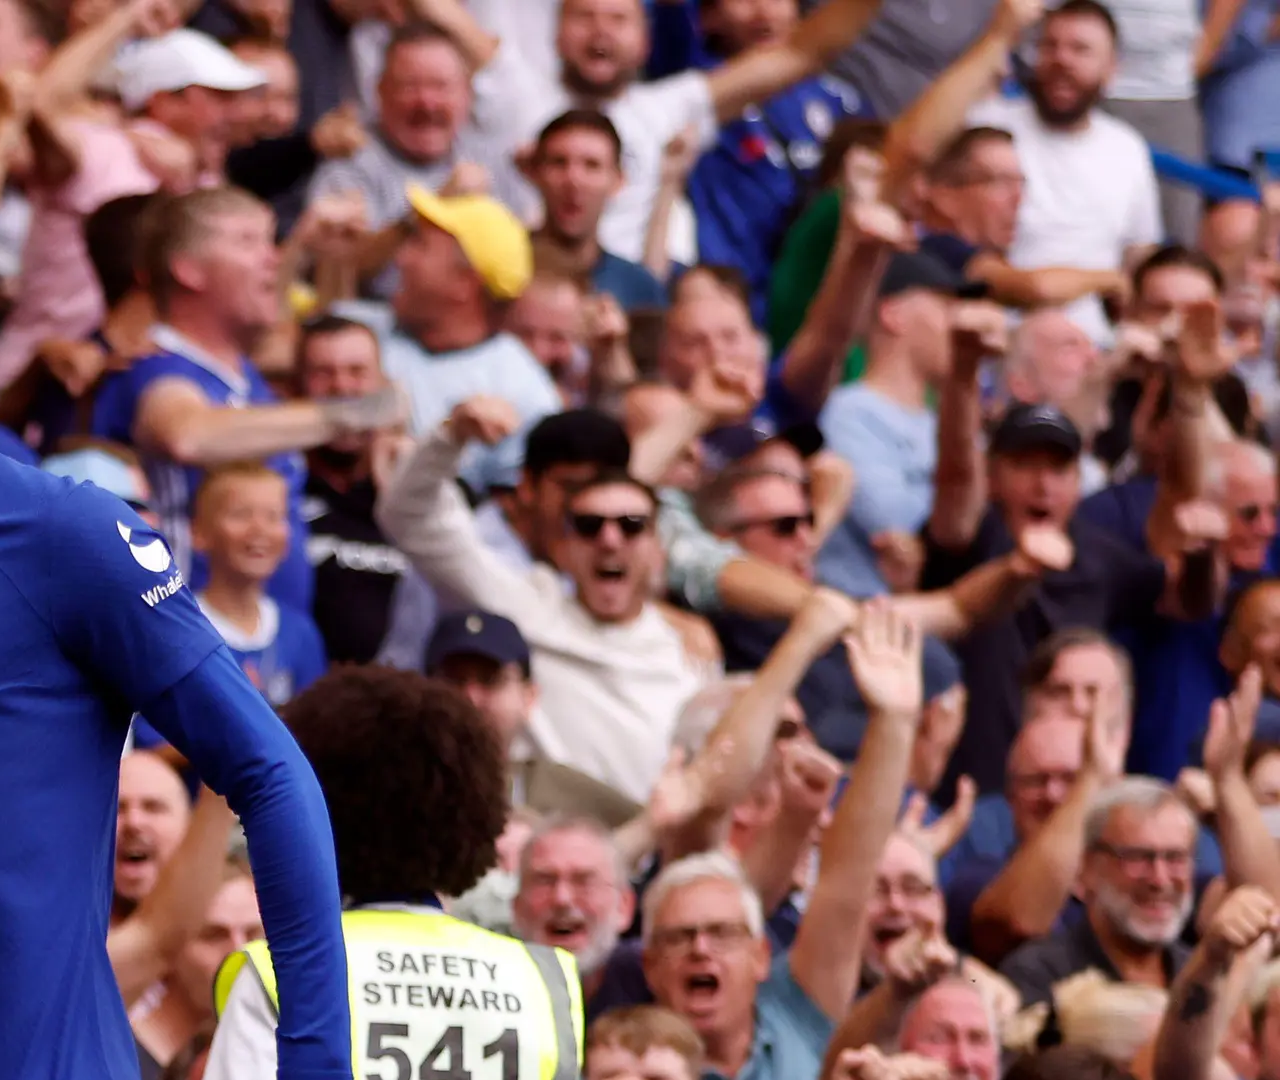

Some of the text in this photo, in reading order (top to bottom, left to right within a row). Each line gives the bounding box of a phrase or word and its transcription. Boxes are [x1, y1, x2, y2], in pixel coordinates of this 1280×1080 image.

[141, 569, 184, 607] Whale
[377, 951, 497, 980] SAFETY
[363, 982, 522, 1013] STEWARD
